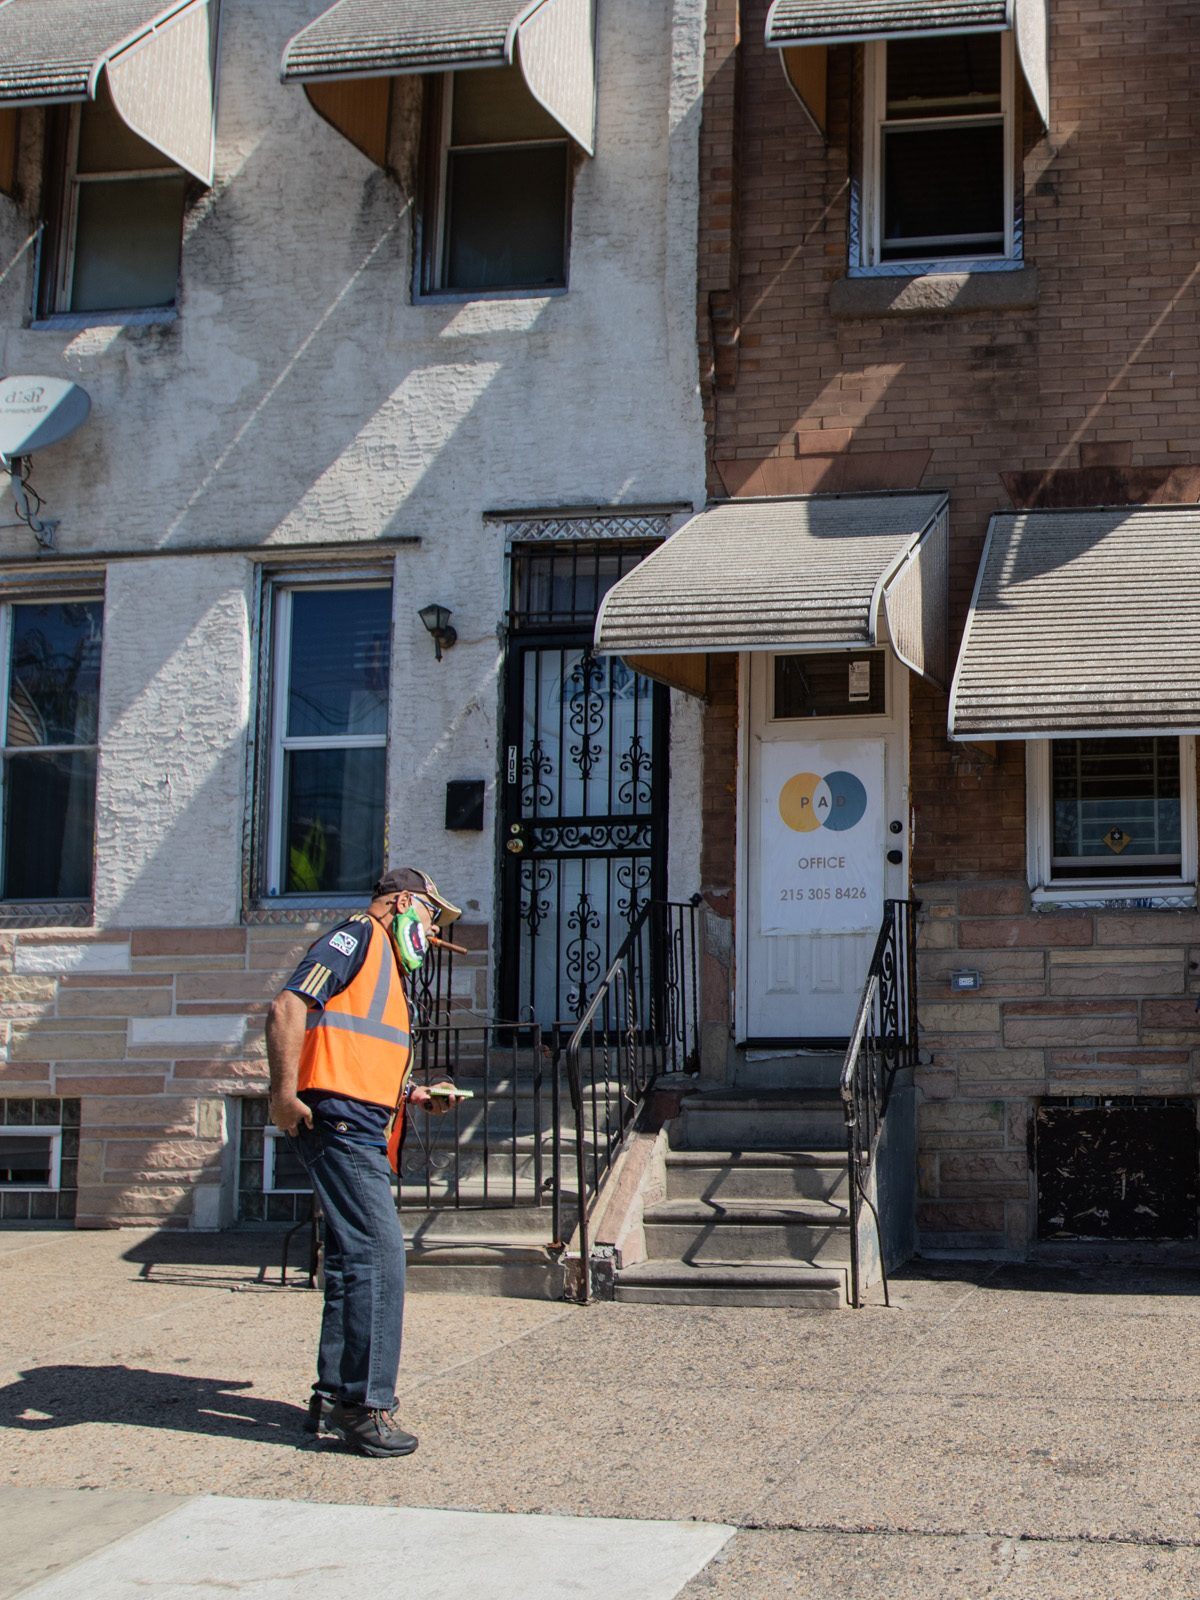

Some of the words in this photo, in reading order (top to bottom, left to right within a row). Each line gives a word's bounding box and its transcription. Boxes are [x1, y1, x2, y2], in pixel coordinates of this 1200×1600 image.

[5, 390, 41, 403] dish
[951, 755, 985, 781] 707
[798, 856, 845, 869] OFFICE
[780, 889, 804, 901] 215
[808, 888, 831, 900] 305
[835, 887, 867, 899] 8426
[331, 941, 350, 954] MLS
